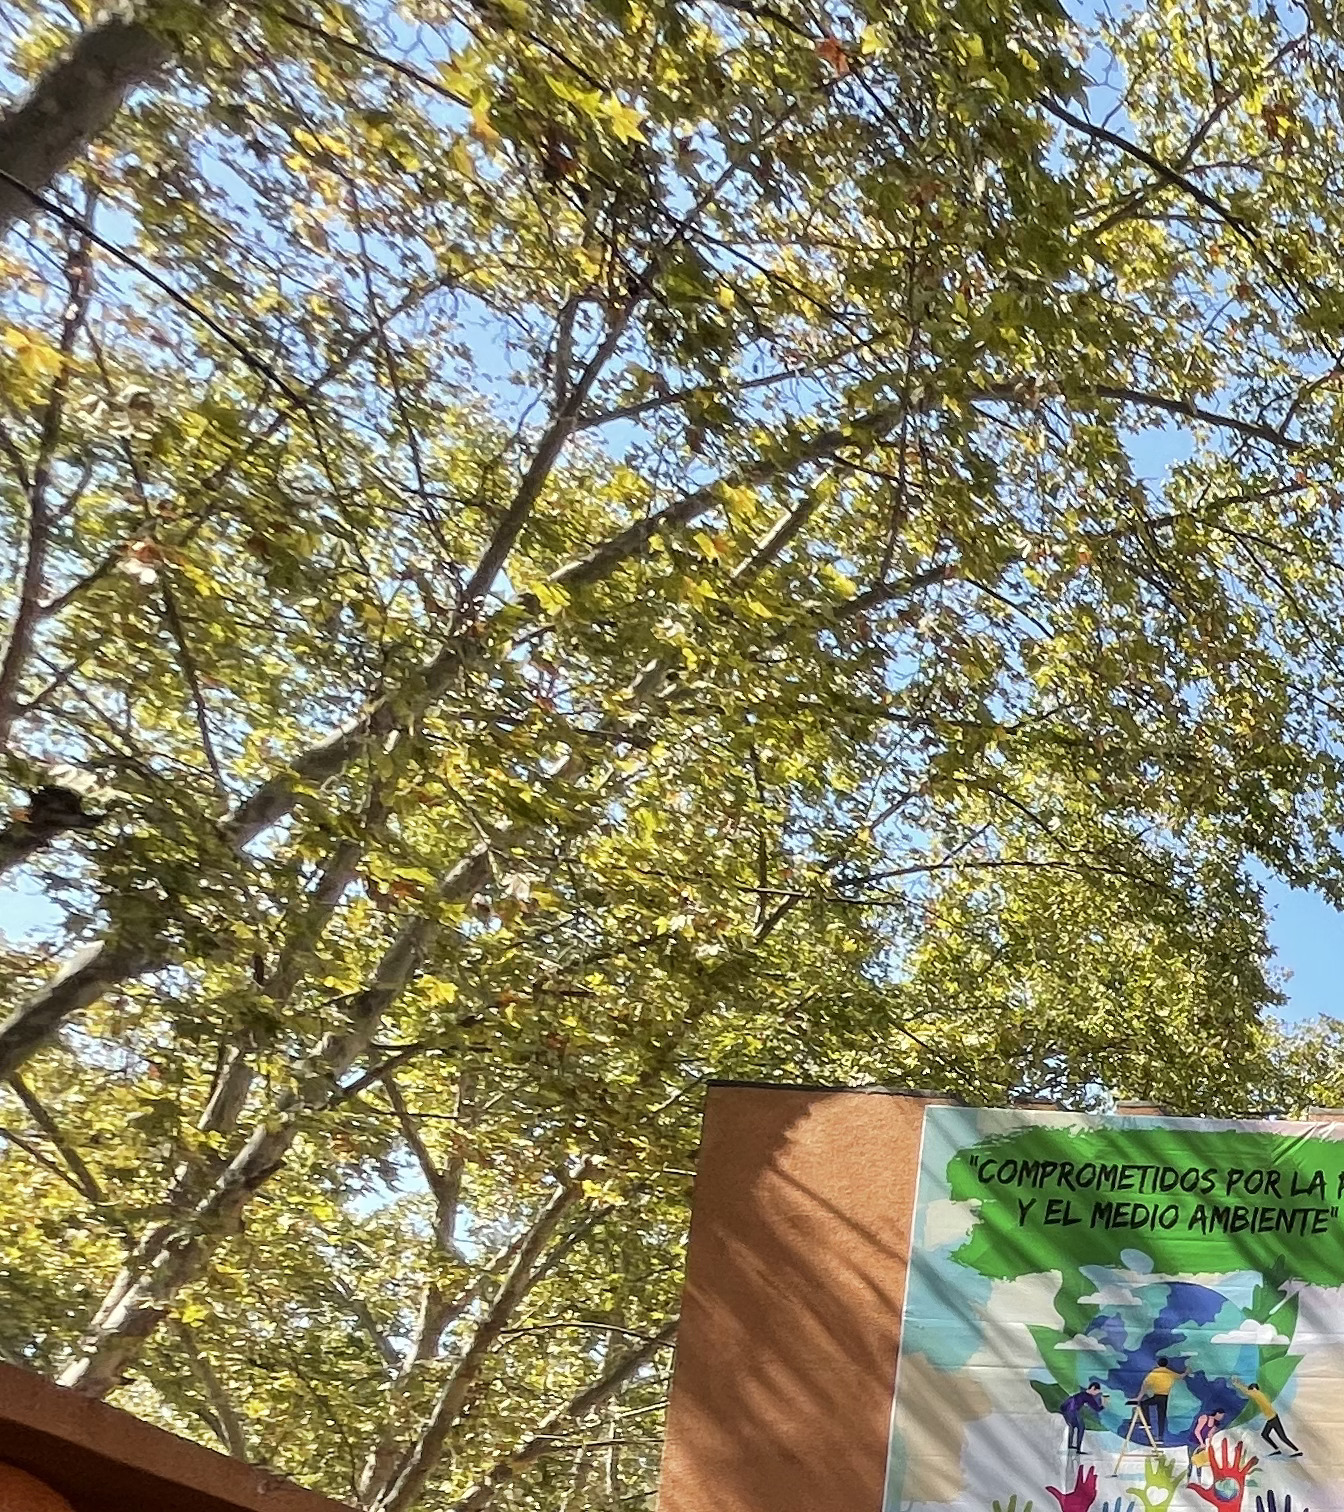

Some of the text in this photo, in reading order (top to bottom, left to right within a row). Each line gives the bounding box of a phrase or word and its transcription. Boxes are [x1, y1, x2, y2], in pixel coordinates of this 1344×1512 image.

[1226, 1168, 1281, 1199] POR
[1290, 1171, 1328, 1199] LA
[1016, 1198, 1038, 1227] Y
[1043, 1201, 1083, 1227] EL
[1090, 1201, 1181, 1232] MEDIO
